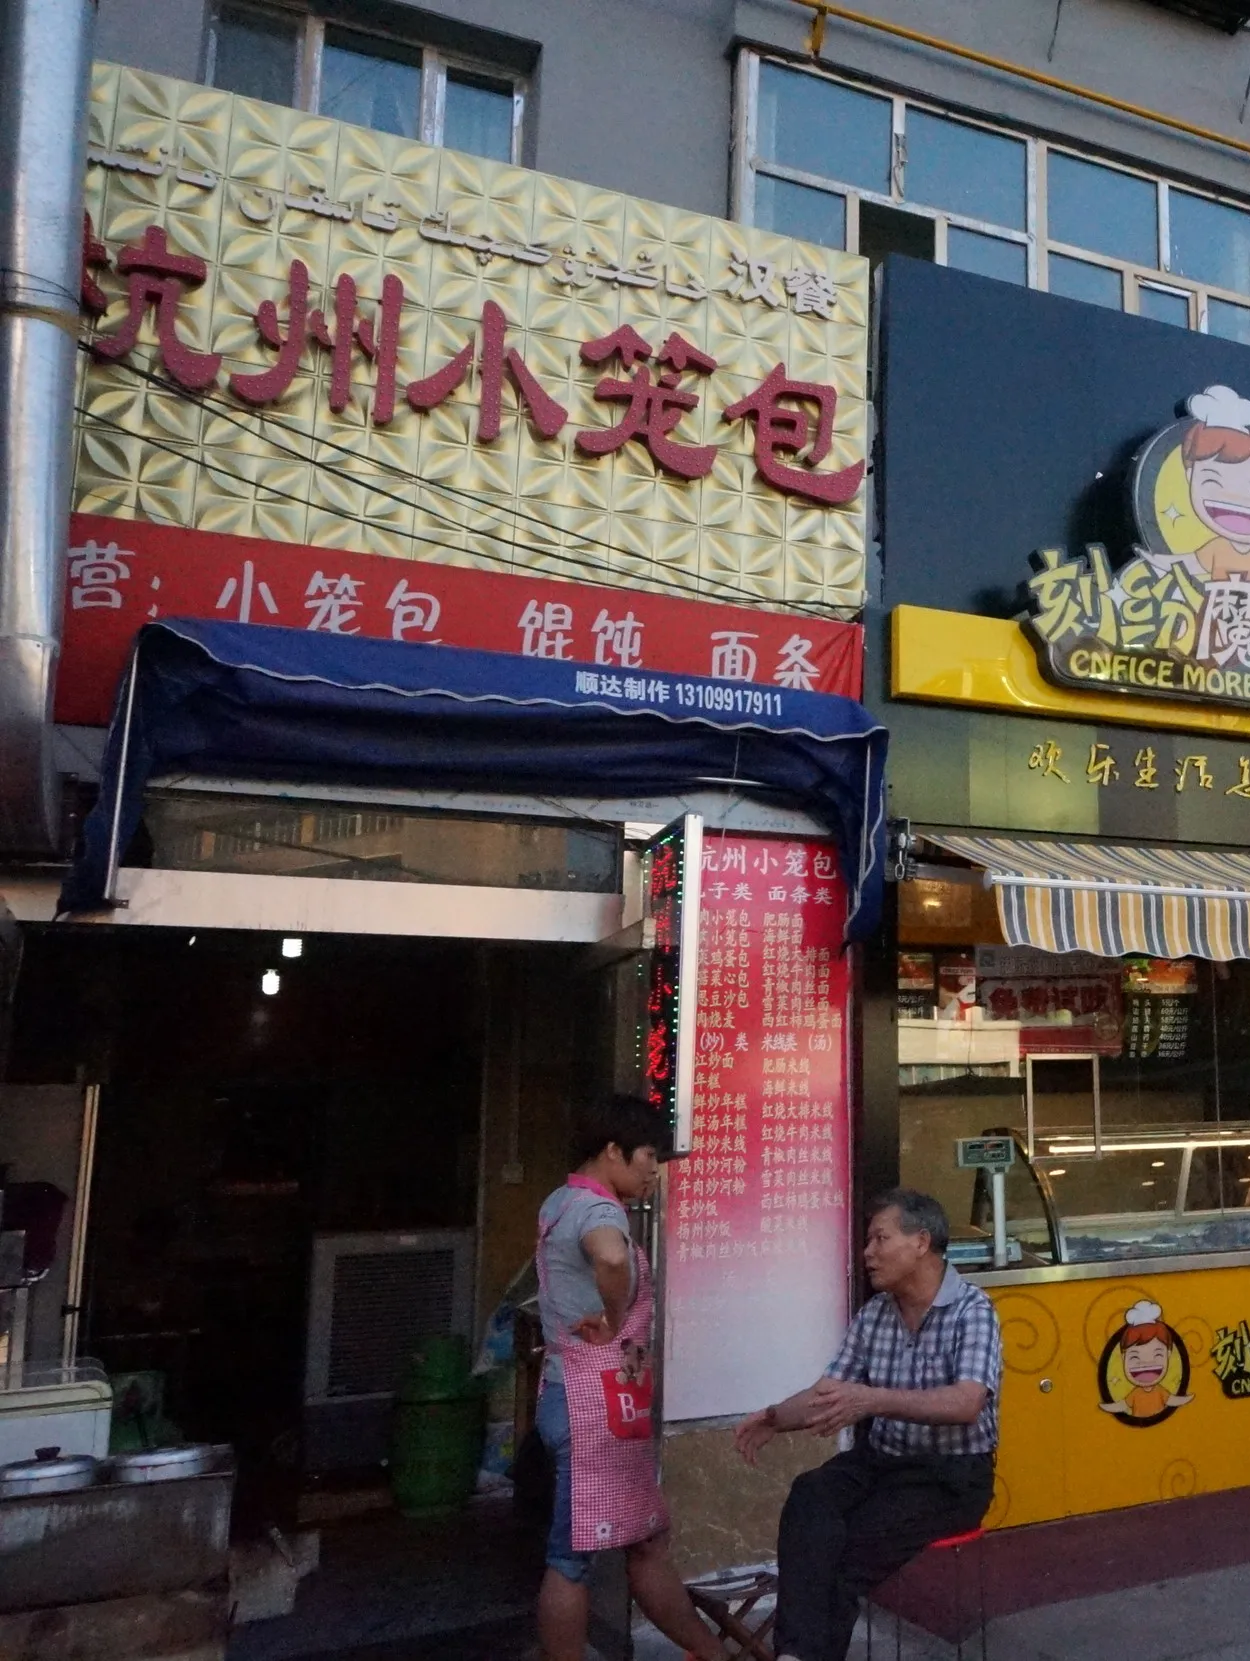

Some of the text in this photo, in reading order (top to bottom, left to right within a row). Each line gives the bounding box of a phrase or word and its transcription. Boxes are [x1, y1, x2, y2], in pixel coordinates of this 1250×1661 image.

[729, 249, 839, 320] 汉餐
[82, 208, 868, 506] 杭州小笼包
[215, 559, 443, 646] 小笼包
[517, 598, 646, 670] 馄饨
[709, 630, 822, 692] 面条
[1069, 648, 1176, 689] CNFICE
[574, 670, 783, 717] 顺达制作 13109917911
[700, 882, 753, 902] 子类
[768, 886, 834, 906] 面条类
[763, 962, 830, 980] 红烧牛肉面
[762, 1012, 842, 1030] 西红柿鸡蛋面
[761, 1123, 834, 1143] 红烧牛肉米线
[678, 1157, 748, 1177] 鸡肉炒河粉
[677, 1178, 747, 1197] 牛肉炒河粉
[677, 1199, 719, 1220] 蛋炒饭
